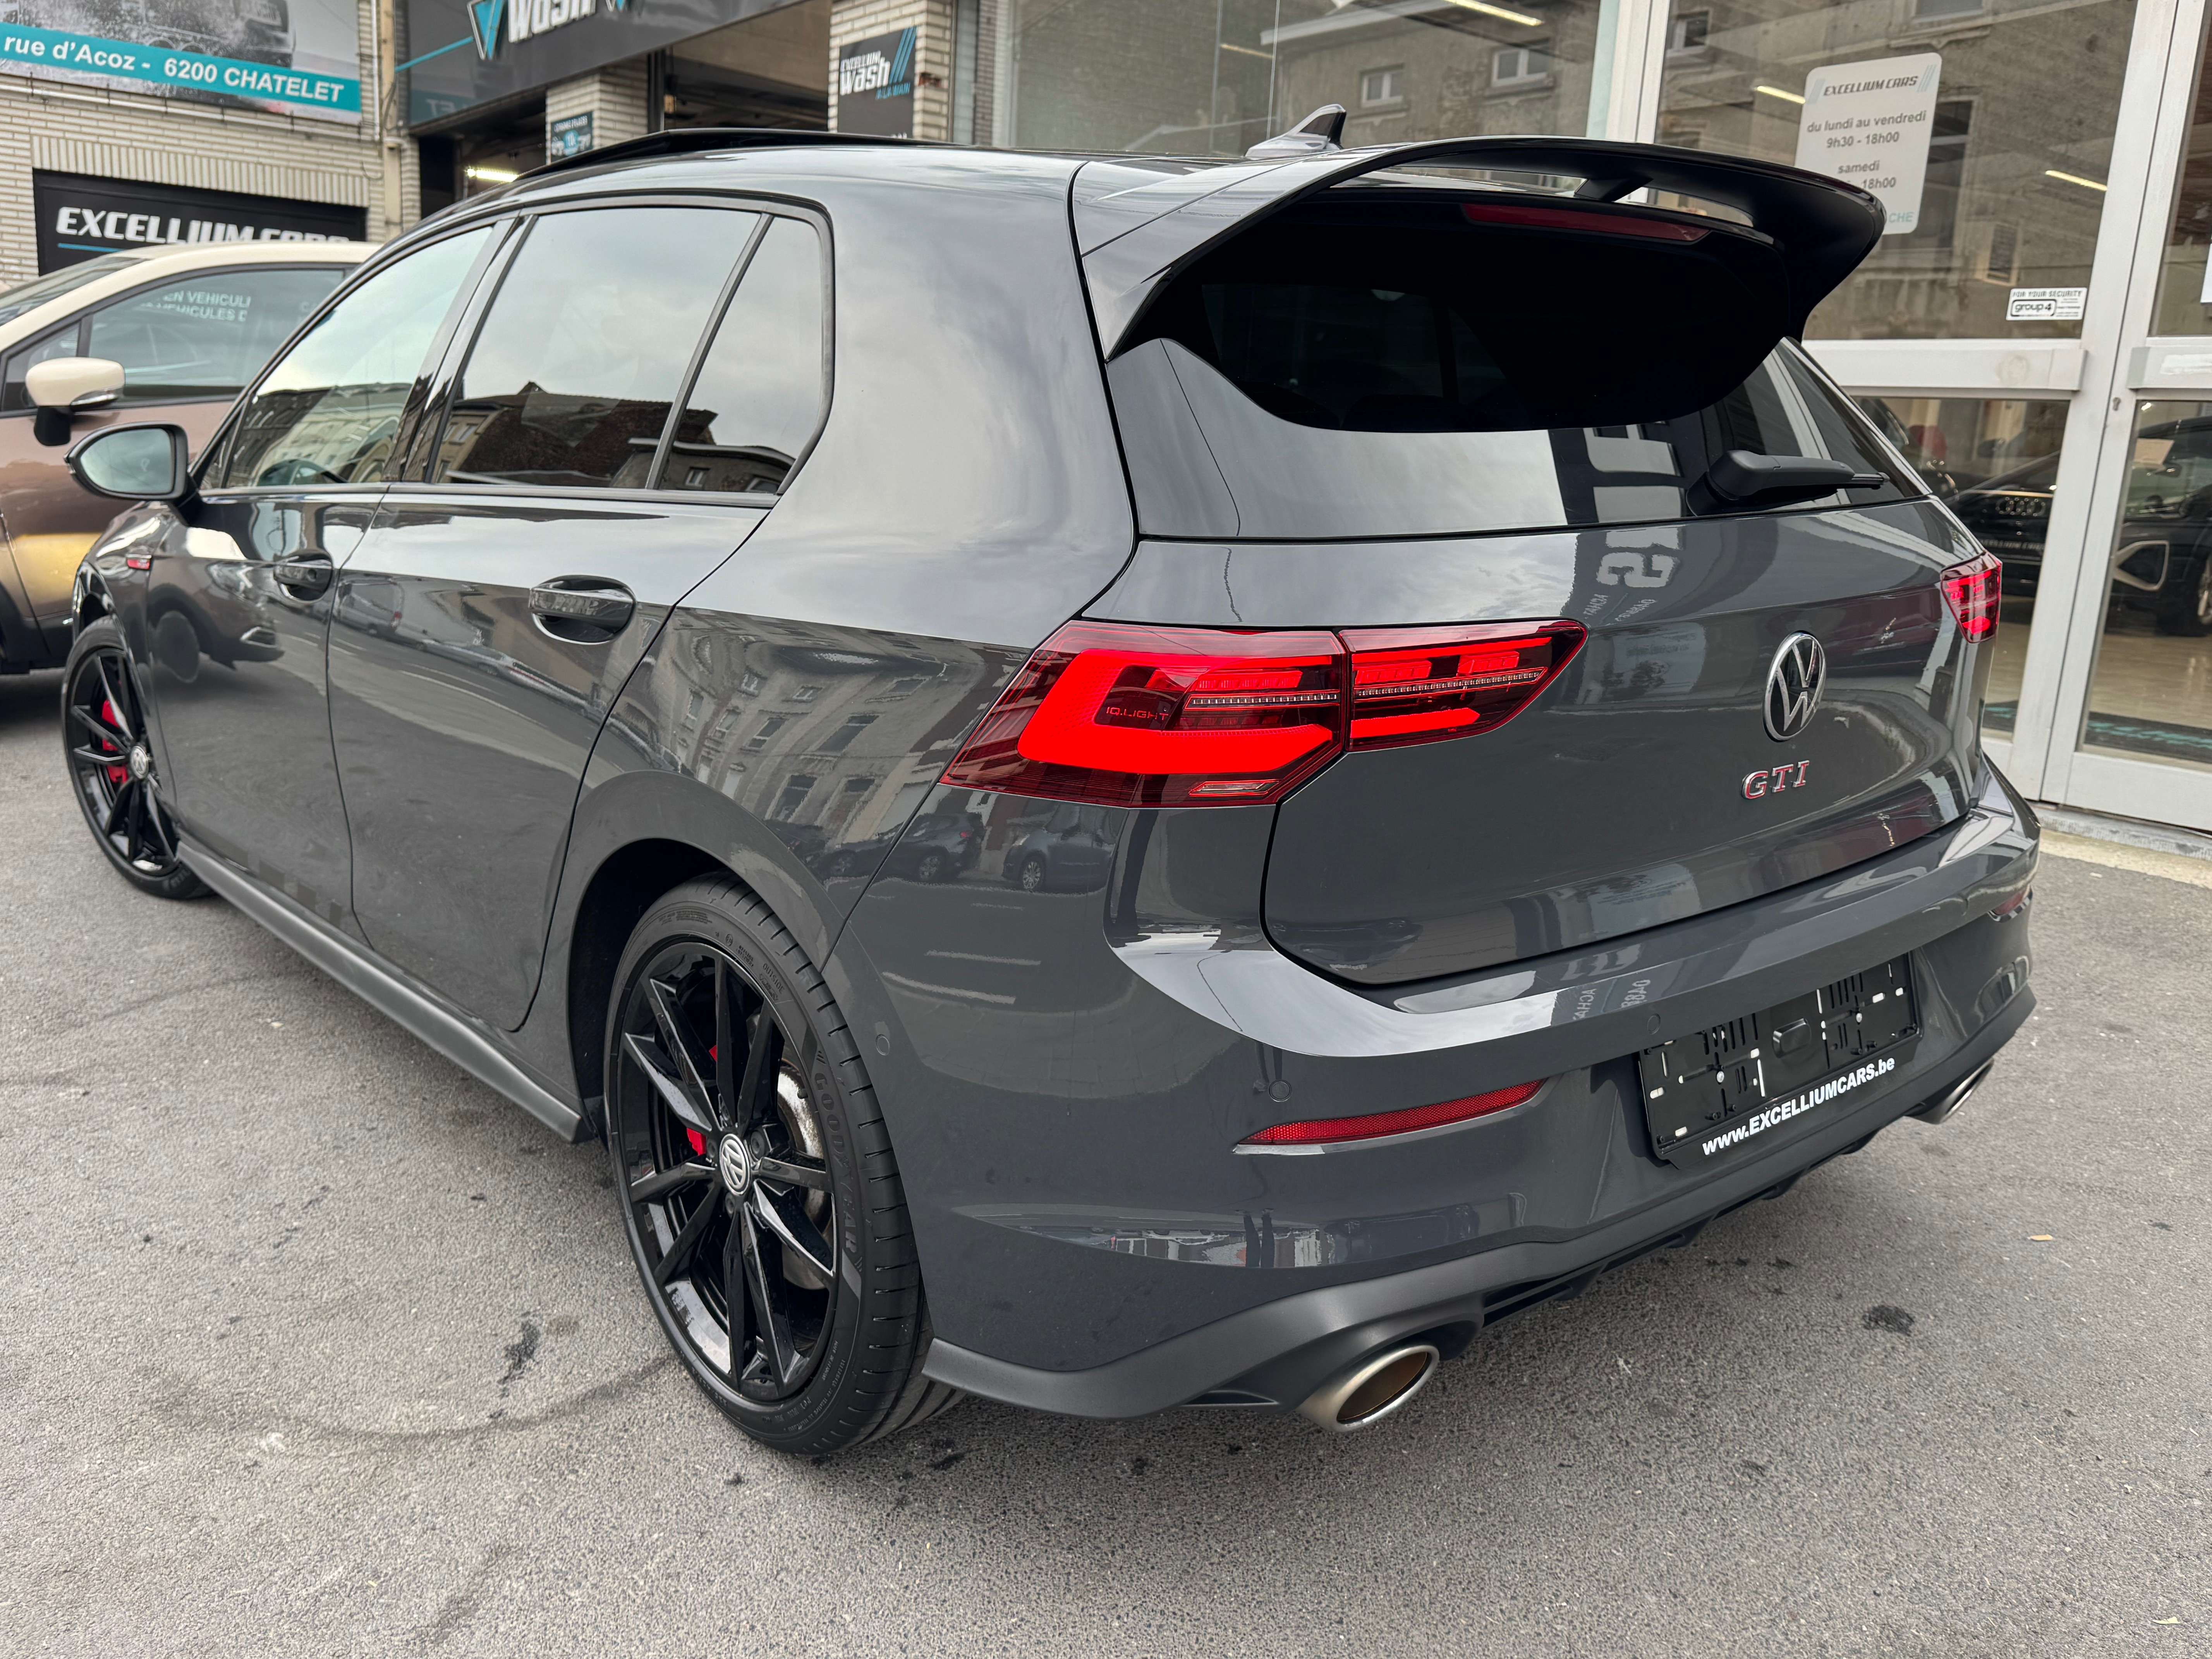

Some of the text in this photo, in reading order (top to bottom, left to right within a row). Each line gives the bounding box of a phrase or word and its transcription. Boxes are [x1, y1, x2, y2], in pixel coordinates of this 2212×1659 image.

[4, 35, 45, 55] rue
[53, 38, 135, 71] d'Acoz
[164, 58, 218, 83] 6200
[224, 67, 344, 102] CHATELET
[1823, 76, 1918, 96] EXCELLIUM CARS
[1807, 110, 1926, 133] du lundi au vendredi
[1826, 136, 1854, 149] 9h30
[1866, 132, 1900, 145] 18h00
[1838, 160, 1880, 174] samedi
[1862, 177, 1896, 189] 18h00
[2015, 303, 2044, 313] group
[1106, 706, 1169, 721] IQ.LIGHT
[1741, 760, 1810, 799] GTI
[763, 963, 786, 994] OUTSIDE
[1702, 1056, 1895, 1156] www.EXCELLIUMCARS.be
[814, 1072, 857, 1253] GOODYEAR
